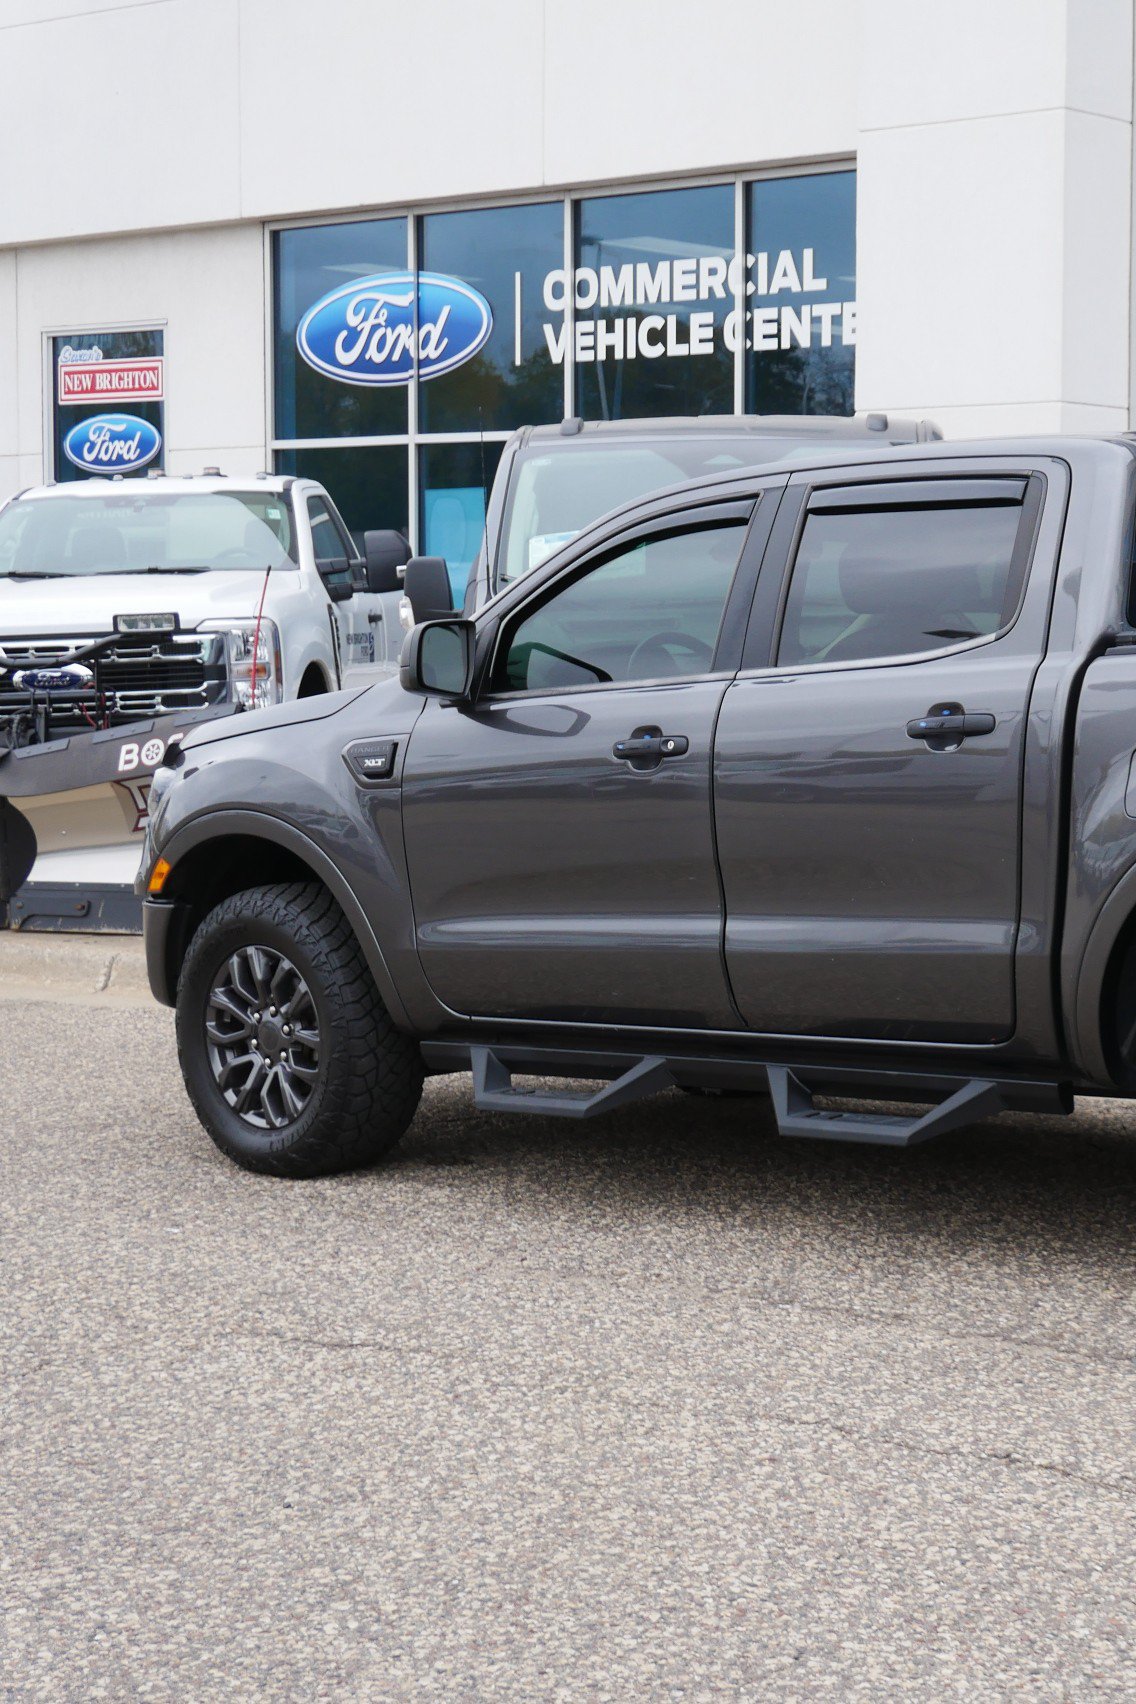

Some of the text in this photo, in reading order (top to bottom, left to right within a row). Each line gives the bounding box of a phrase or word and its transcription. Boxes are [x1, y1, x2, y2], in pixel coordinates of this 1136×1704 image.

[543, 248, 827, 311] COMMERCIAL
[334, 290, 452, 366] Ford
[543, 312, 714, 364] VEHICLE
[64, 370, 158, 392] NEW BRIGHTON
[83, 421, 142, 462] Ford
[364, 758, 385, 767] XLT
